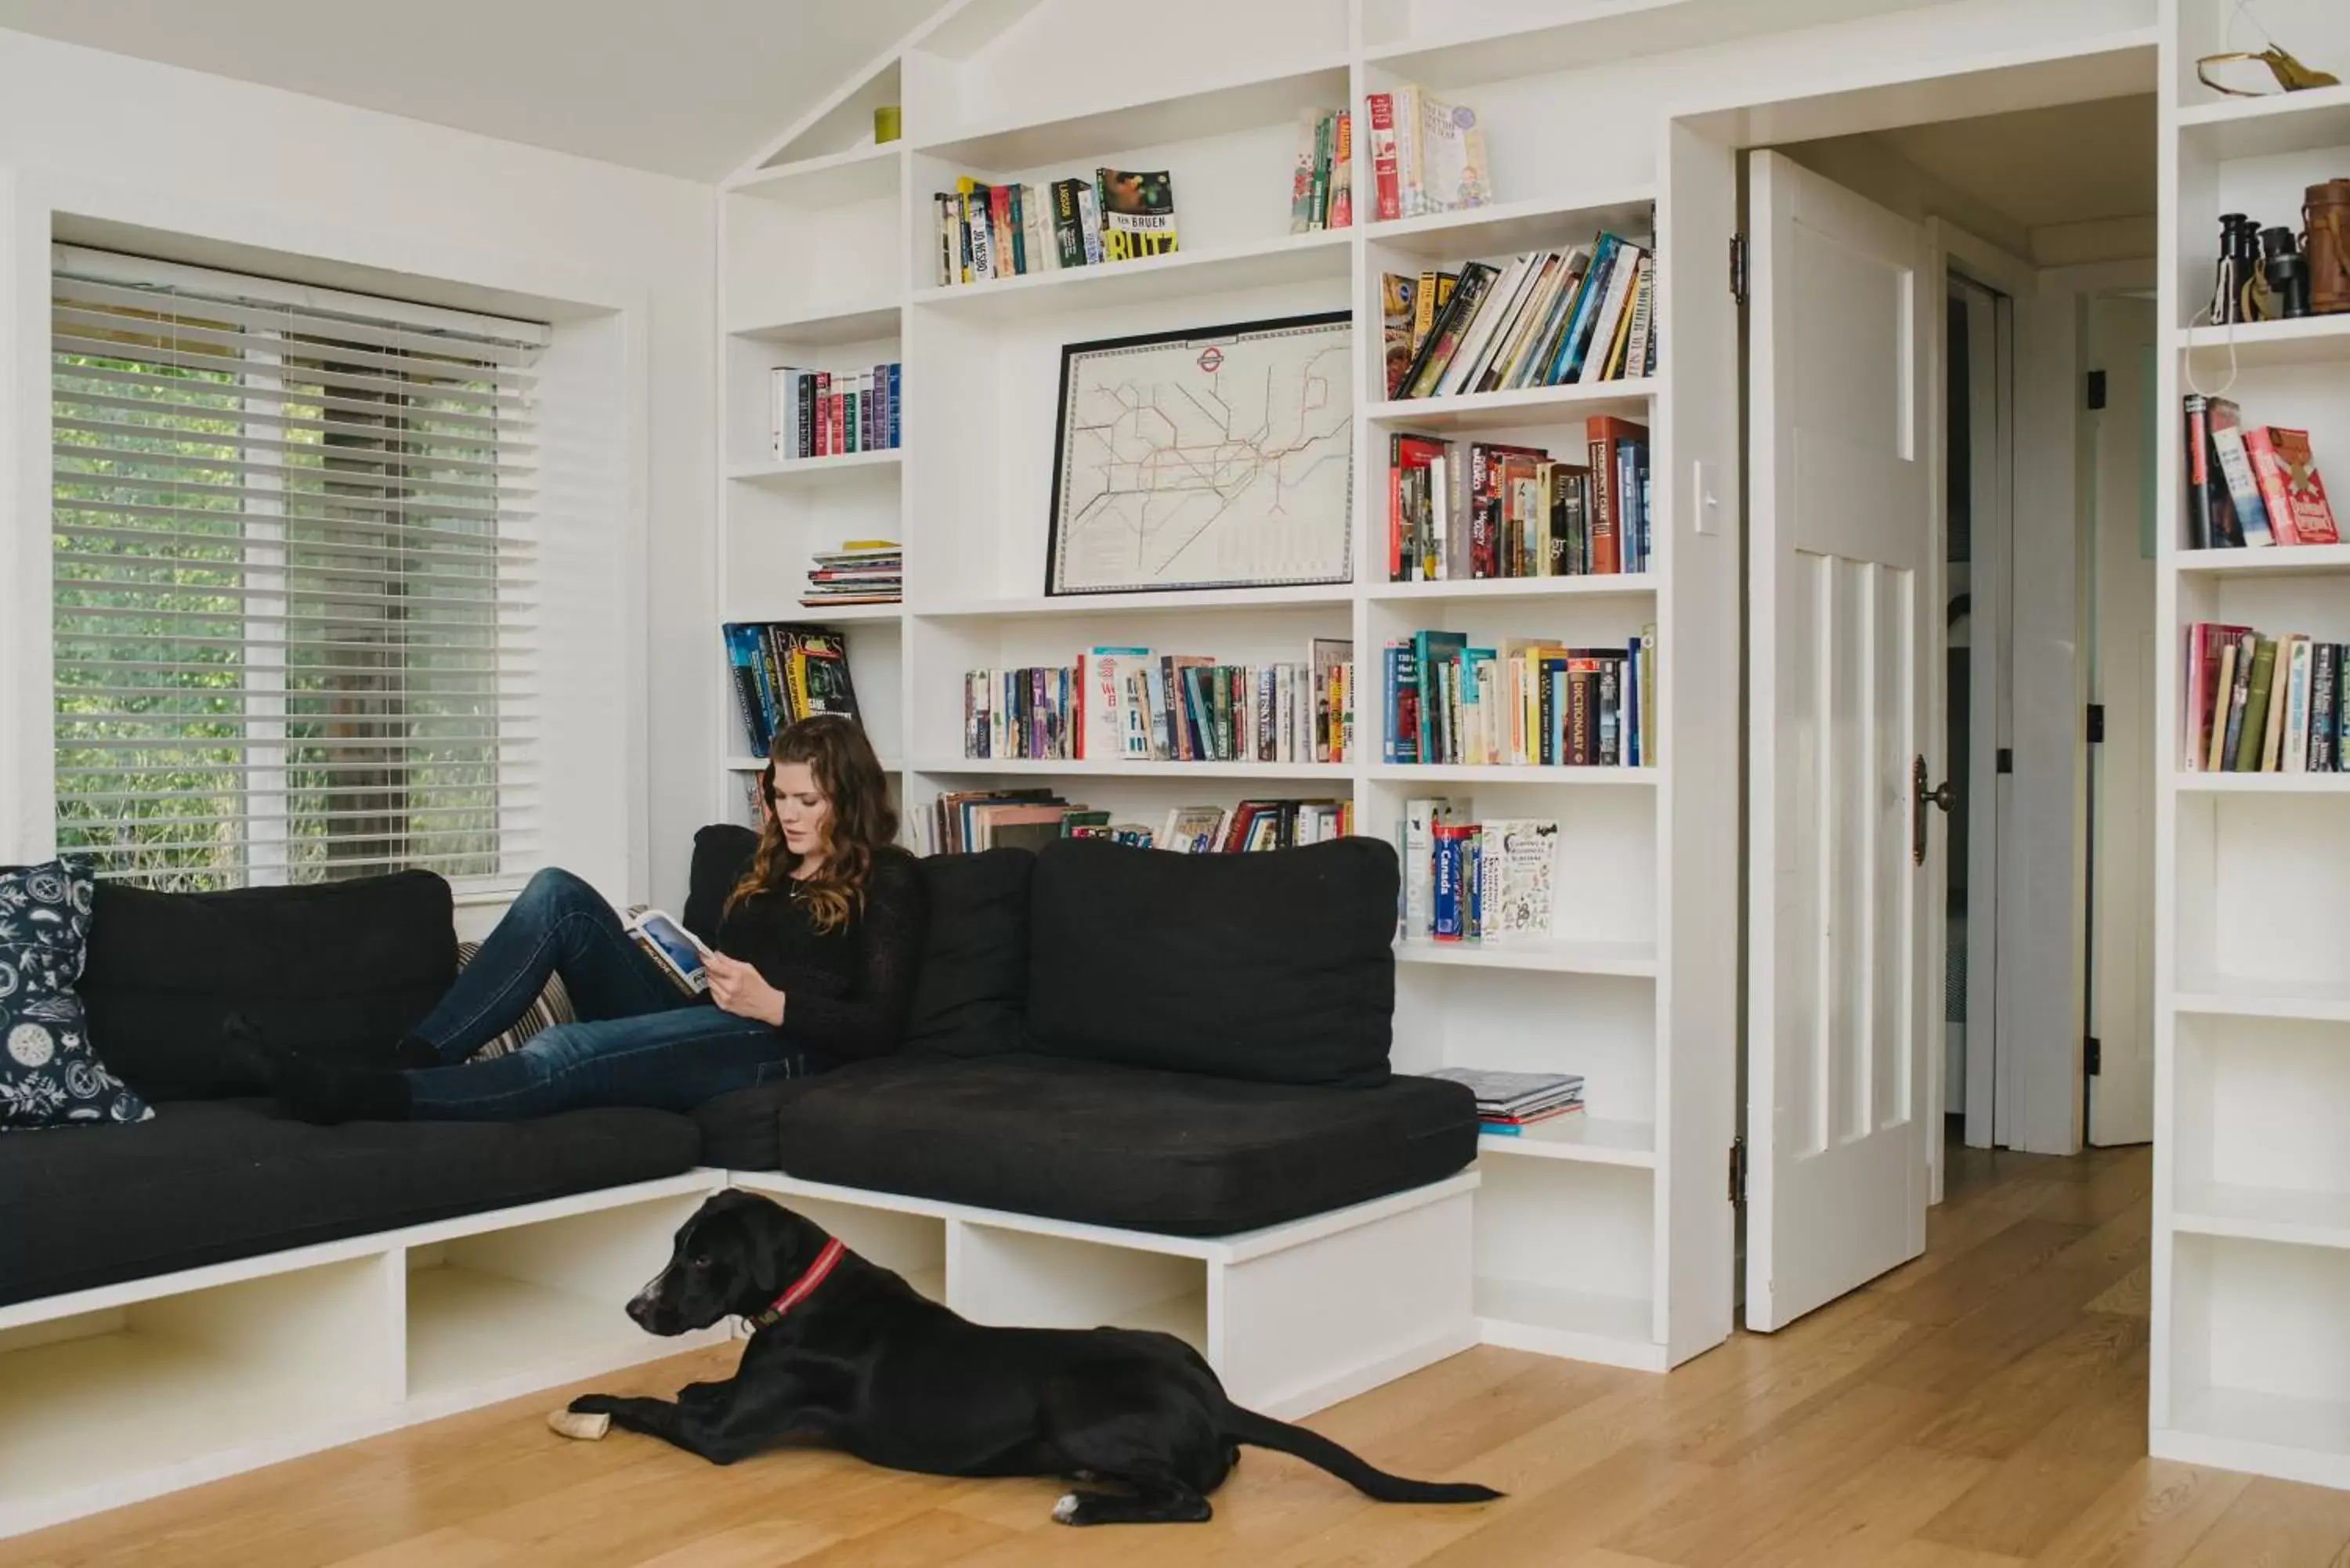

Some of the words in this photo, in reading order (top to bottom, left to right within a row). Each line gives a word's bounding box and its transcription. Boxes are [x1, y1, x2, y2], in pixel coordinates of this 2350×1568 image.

[1132, 216, 1166, 227] BRUEN
[1574, 682, 1585, 751] DICTIONARY
[1441, 851, 1450, 894] Canada
